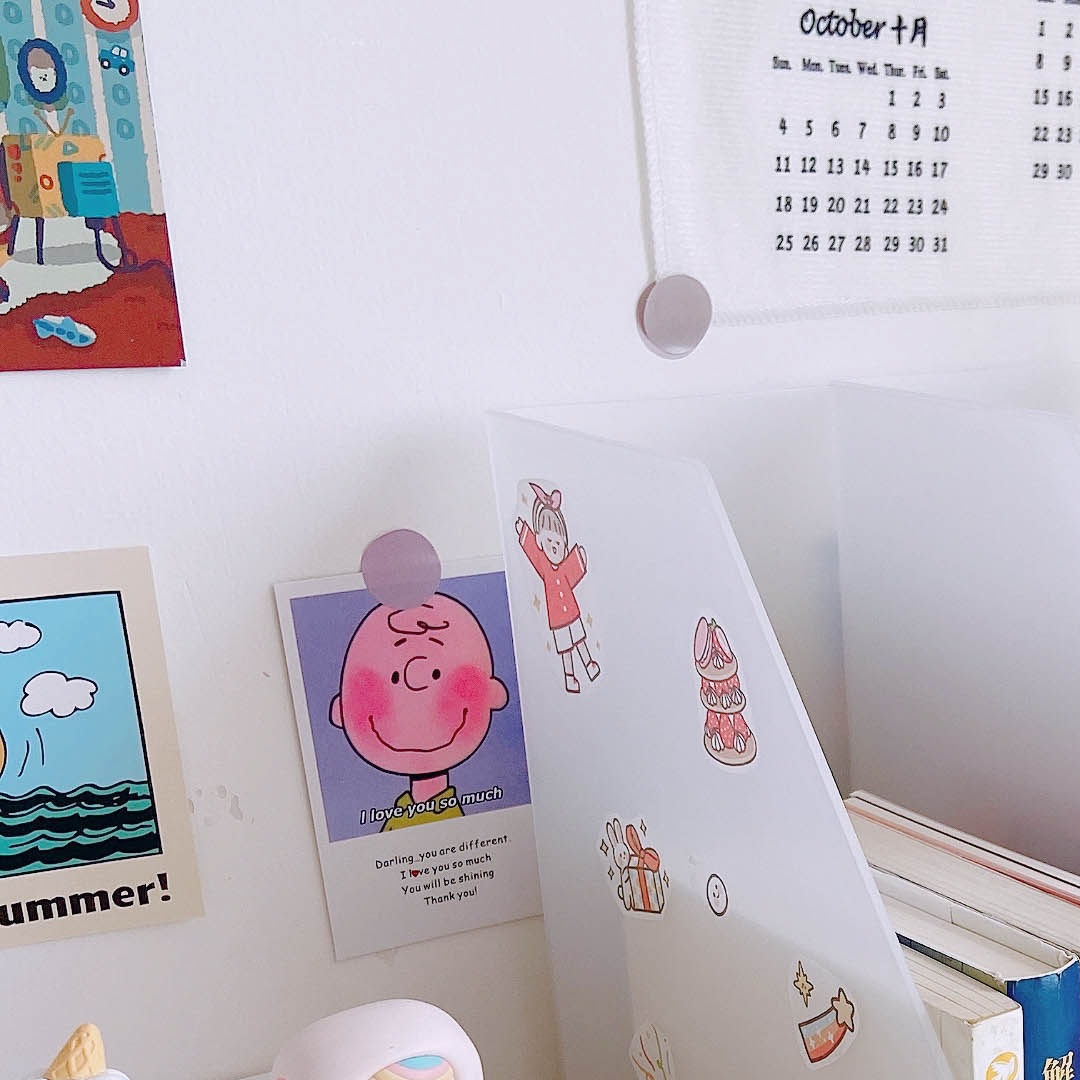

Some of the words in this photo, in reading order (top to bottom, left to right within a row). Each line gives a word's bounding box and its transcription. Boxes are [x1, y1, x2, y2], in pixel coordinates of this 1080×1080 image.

[800, 8, 887, 39] October
[891, 15, 928, 47] 十月
[1038, 20, 1045, 37] 1
[1064, 22, 1074, 39] 2
[1063, 54, 1072, 72] 9
[888, 89, 896, 107] 1
[913, 90, 921, 108] 2
[938, 92, 946, 110] 3
[1033, 88, 1049, 106] 15
[1057, 90, 1073, 107] 16
[778, 117, 788, 136] 4
[805, 119, 814, 137] 5
[831, 120, 840, 138] 6
[858, 121, 867, 140] 7
[887, 123, 897, 141] 8
[912, 123, 921, 142] 9
[933, 125, 950, 143] 10
[1032, 126, 1049, 143] 22
[1056, 127, 1072, 144] 23
[774, 155, 791, 174] 11
[800, 156, 817, 174] 12
[827, 157, 844, 176] 13
[853, 158, 871, 176] 14
[883, 159, 899, 177] 15
[907, 160, 923, 178] 16
[931, 161, 949, 179] 17
[1032, 162, 1049, 180] 29
[1056, 163, 1073, 180] 30
[775, 195, 793, 213] 18
[802, 195, 819, 214] 19
[827, 196, 846, 214] 20
[853, 197, 871, 215] 21
[883, 198, 899, 215] 22
[906, 198, 924, 216] 23
[931, 198, 949, 215] 24
[775, 234, 794, 252] 25
[802, 234, 819, 252] 26
[828, 234, 846, 253] 27
[854, 235, 872, 253] 28
[883, 235, 900, 253] 29
[908, 235, 925, 253] 30
[932, 236, 948, 253] 31
[360, 808, 367, 824] I
[370, 805, 403, 822] love
[407, 801, 435, 818] you
[439, 797, 457, 809] so
[462, 786, 503, 805] much
[439, 846, 457, 856] are
[400, 869, 407, 880] I
[431, 864, 450, 876] you
[452, 860, 464, 869] so
[465, 853, 492, 866] much
[401, 885, 421, 896] You
[423, 878, 441, 891] will
[443, 875, 457, 886] be
[458, 869, 495, 883] shining
[423, 892, 455, 906] Thank
[456, 887, 478, 900] you!
